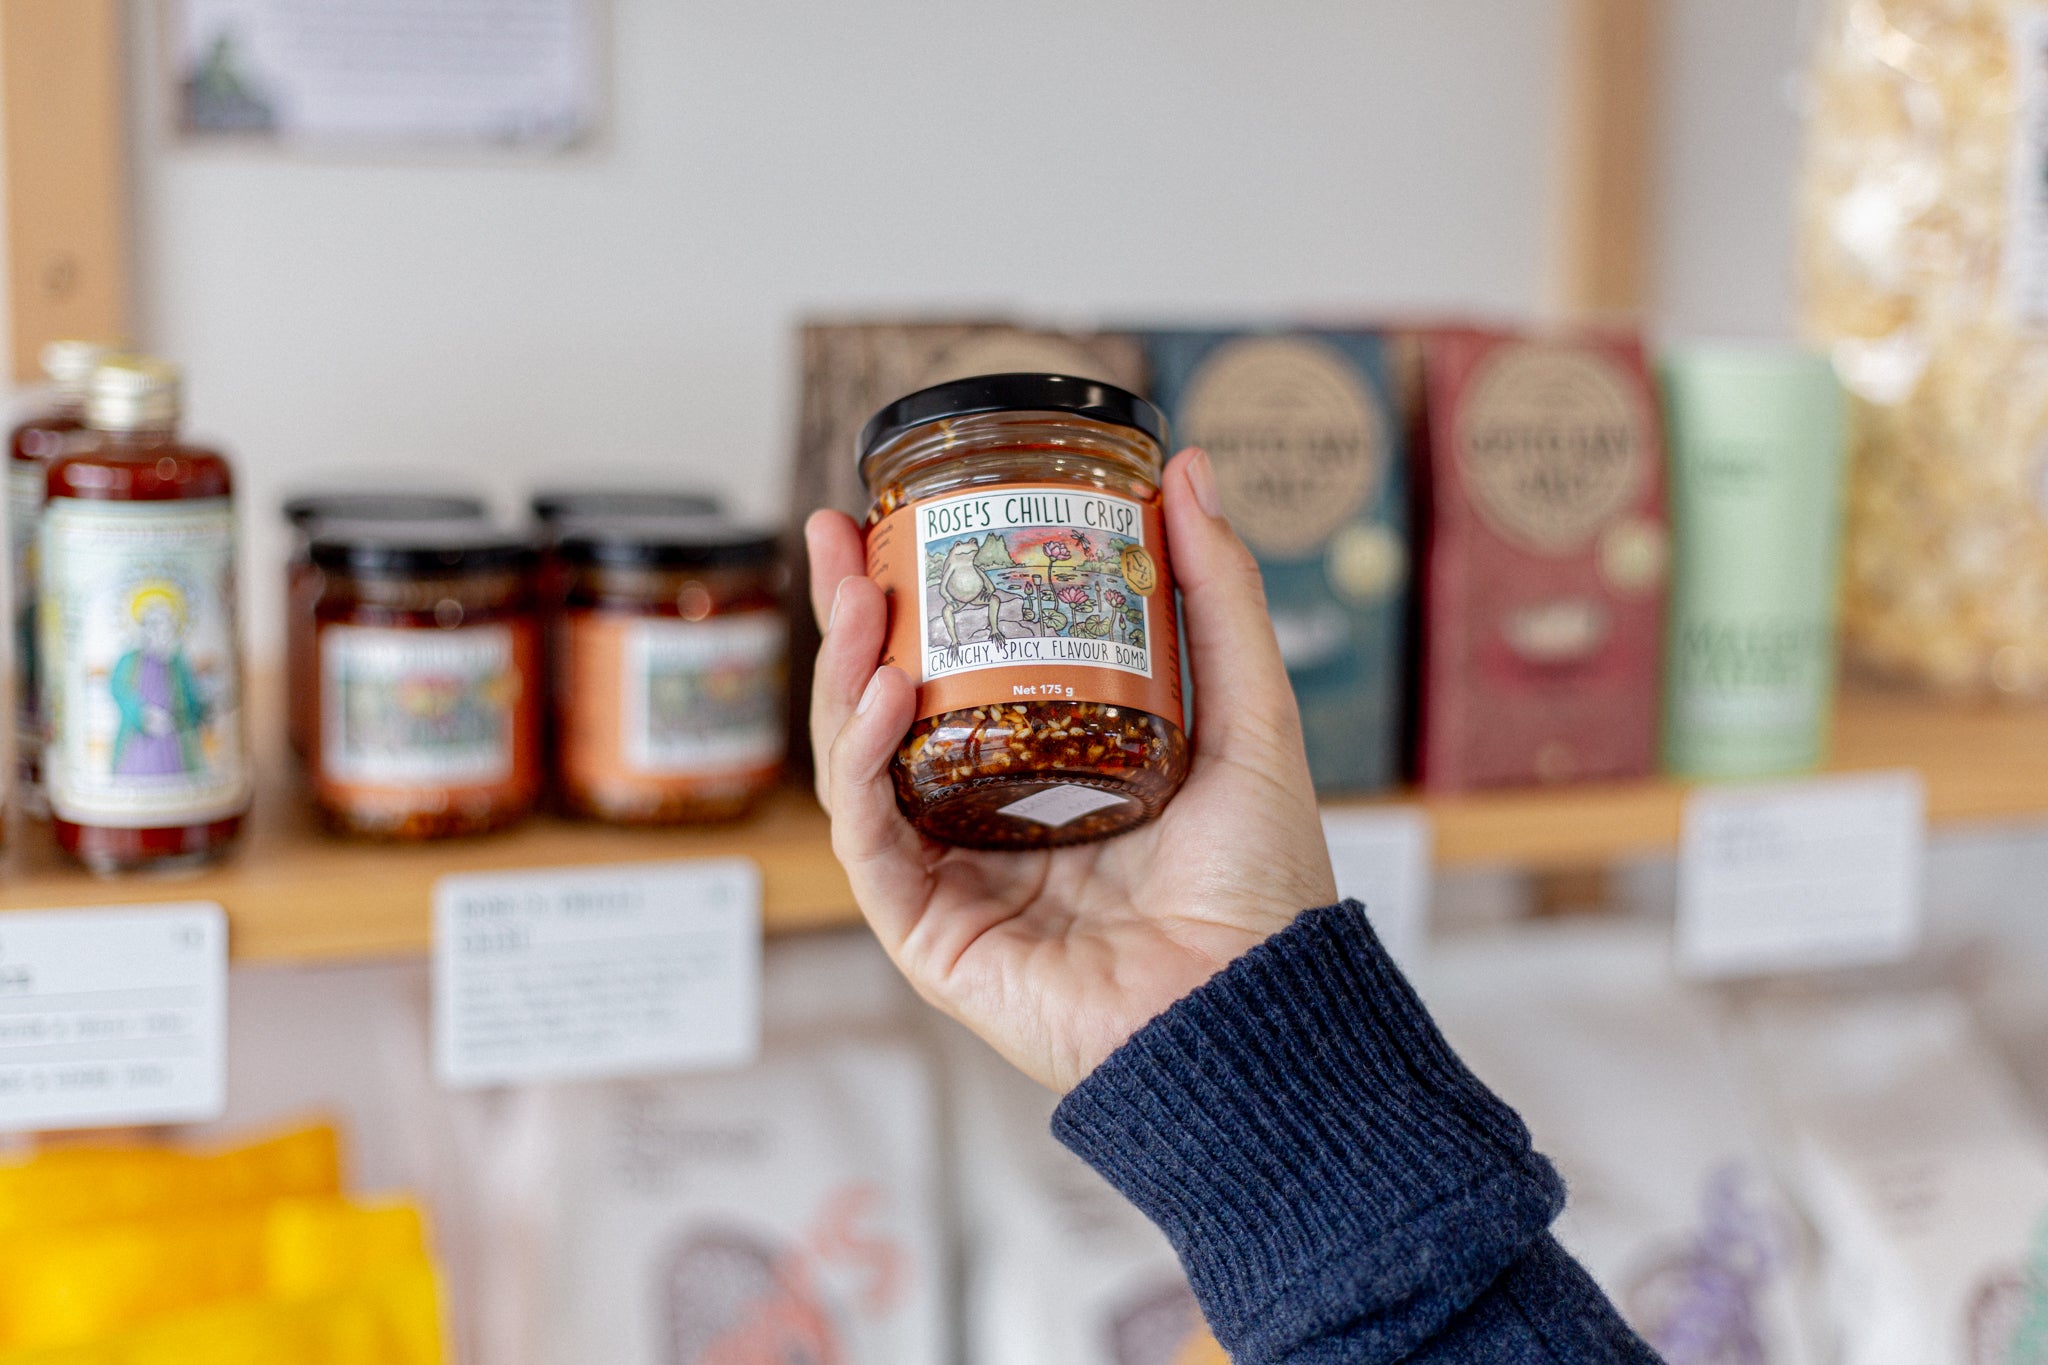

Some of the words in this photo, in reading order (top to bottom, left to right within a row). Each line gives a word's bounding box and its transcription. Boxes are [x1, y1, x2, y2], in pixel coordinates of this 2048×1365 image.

[928, 500, 991, 538] ROSE'S
[1006, 496, 1071, 524] CHILLI
[1084, 500, 1133, 536] CRISP
[931, 645, 993, 672] CRUNCHY,
[1002, 640, 1044, 661] SPICY,
[1053, 640, 1109, 661] FLAVOUR
[1116, 646, 1146, 670] BOMB
[1013, 685, 1036, 696] Net
[1040, 684, 1062, 695] 175
[1066, 687, 1073, 697] g
